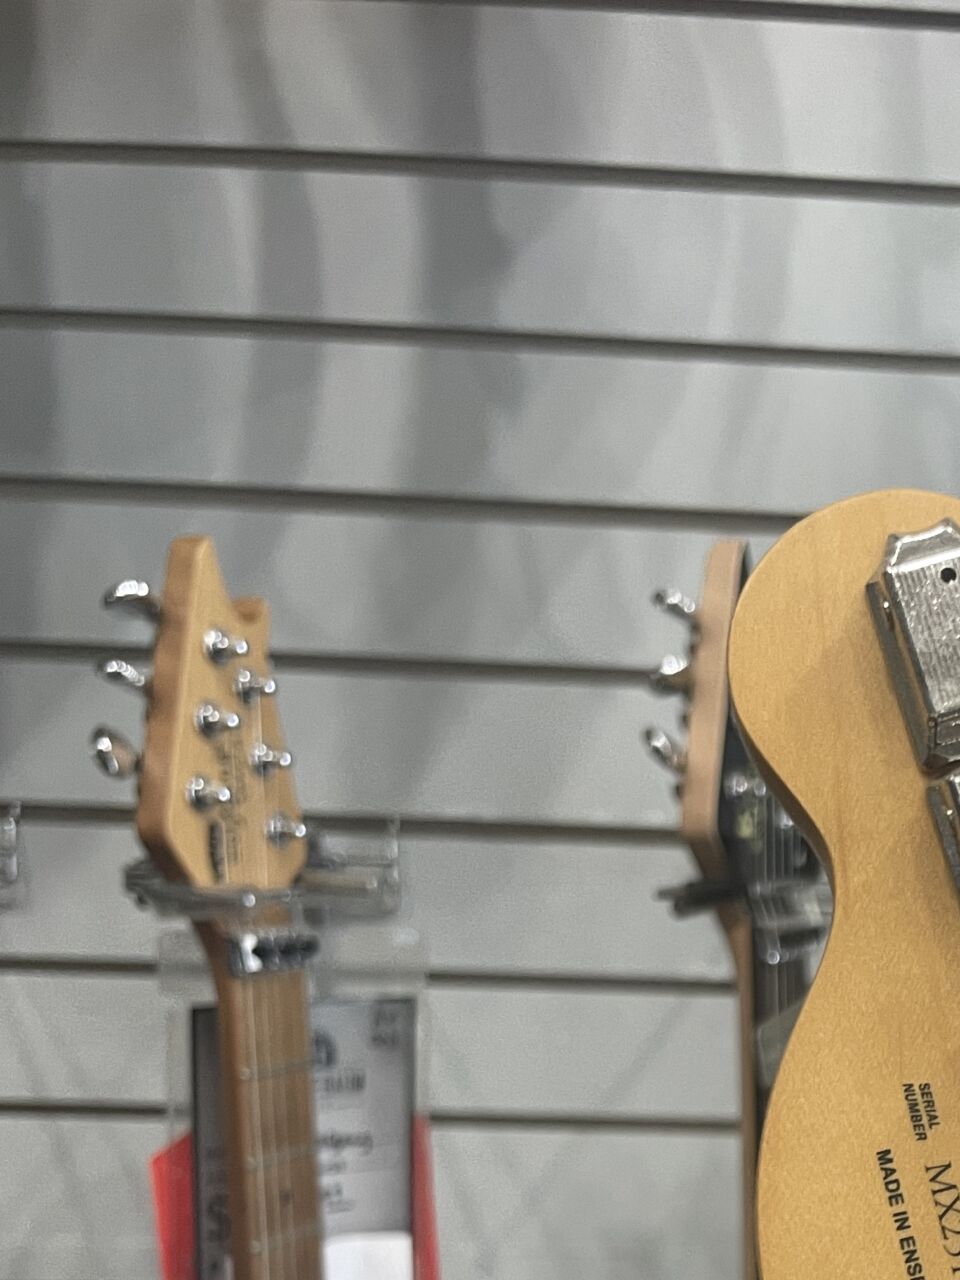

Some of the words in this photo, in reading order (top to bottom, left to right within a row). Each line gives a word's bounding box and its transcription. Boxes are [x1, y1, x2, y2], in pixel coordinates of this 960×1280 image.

[902, 1082, 927, 1142] NUMBER
[918, 1082, 941, 1130] SERIAL
[876, 1148, 905, 1208] MADE
[892, 1211, 911, 1232] IN
